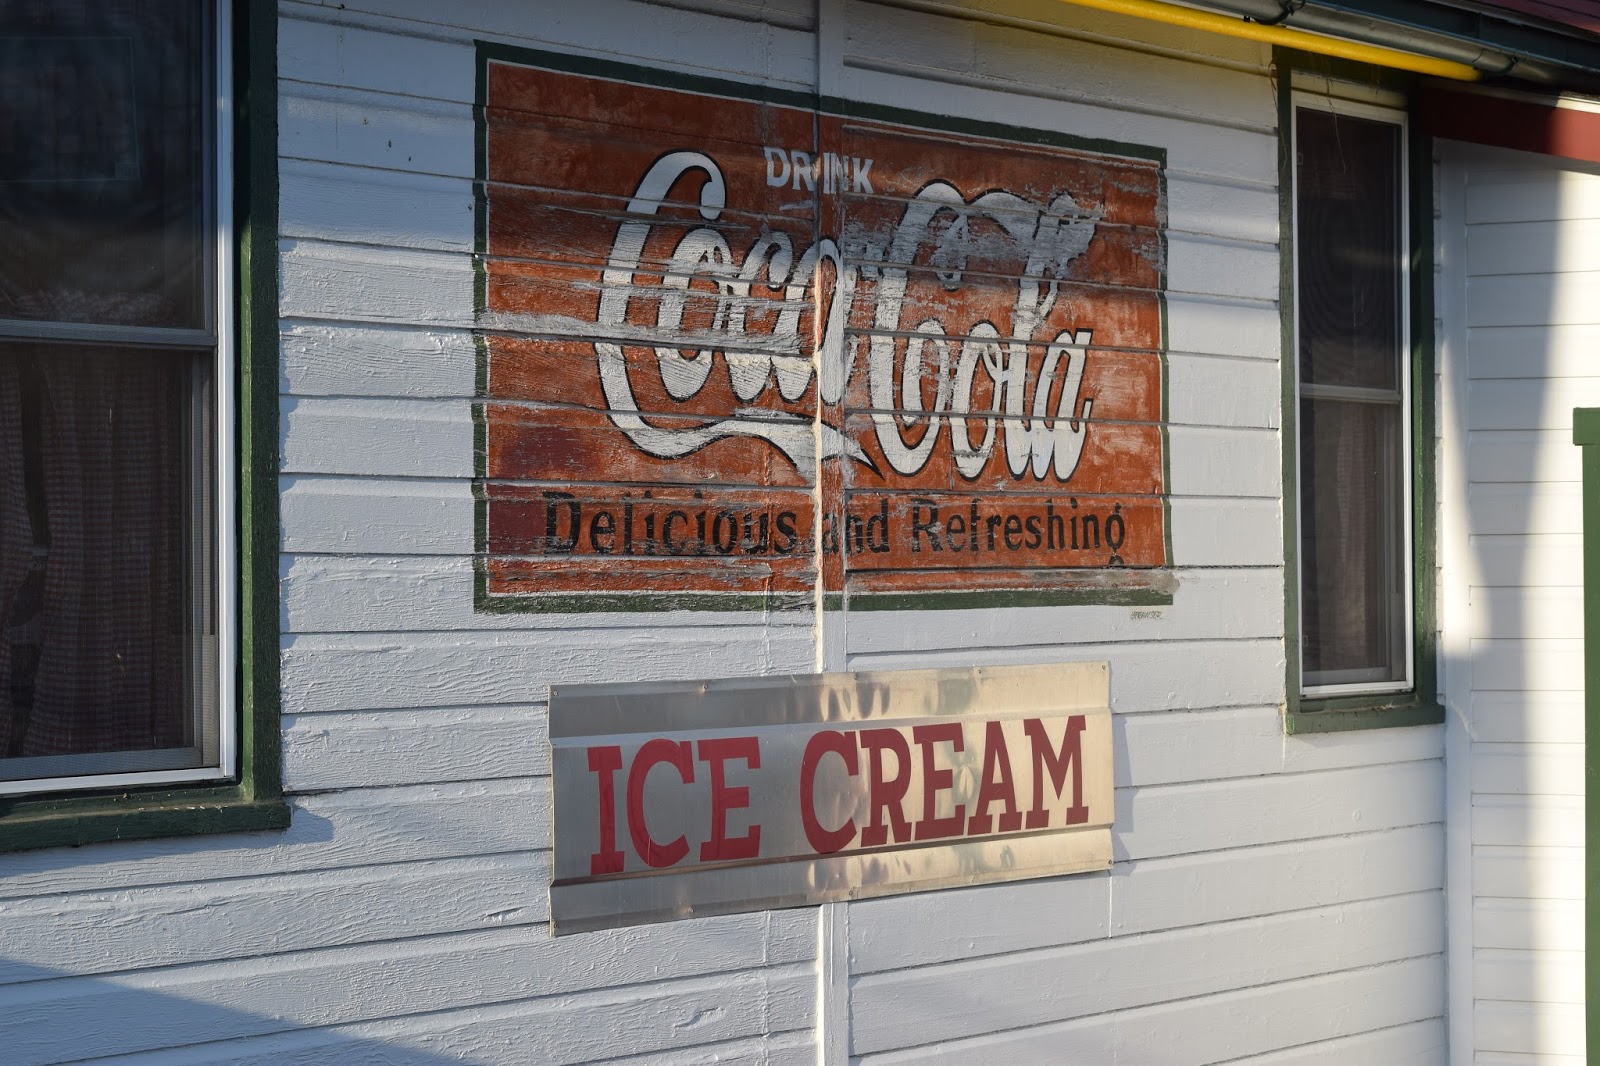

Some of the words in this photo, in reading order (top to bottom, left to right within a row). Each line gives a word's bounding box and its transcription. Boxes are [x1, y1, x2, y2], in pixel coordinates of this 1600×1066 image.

[764, 146, 874, 194] DRINK
[543, 491, 798, 555] Delicious
[821, 496, 890, 555] and
[910, 495, 1126, 566] Refreshing
[587, 736, 761, 876] ICE
[801, 714, 1090, 855] CREAM
